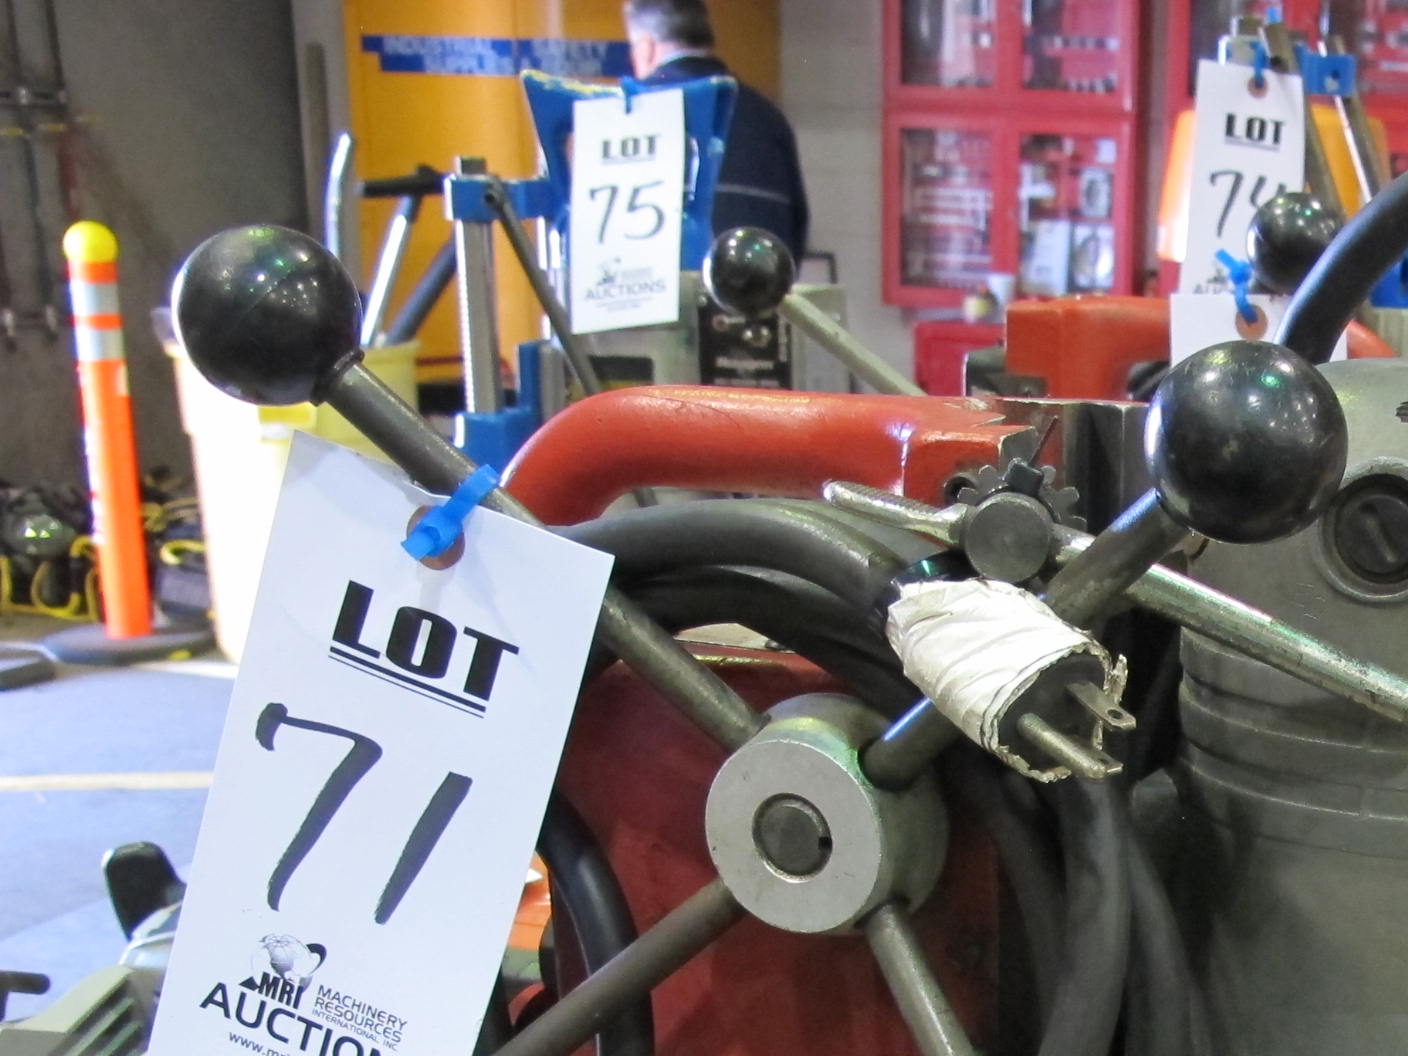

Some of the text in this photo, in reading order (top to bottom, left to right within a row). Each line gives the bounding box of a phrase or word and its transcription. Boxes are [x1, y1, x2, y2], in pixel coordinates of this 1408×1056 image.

[601, 133, 660, 160] LOT
[1225, 112, 1284, 145] LOT
[589, 180, 666, 243] 75
[585, 279, 666, 301] AUCTIONS
[333, 580, 519, 701] LOT
[255, 702, 473, 924] 71
[258, 971, 303, 1009] MRI
[318, 985, 408, 1031] MACHINERY
[314, 997, 402, 1043] RESOURCES
